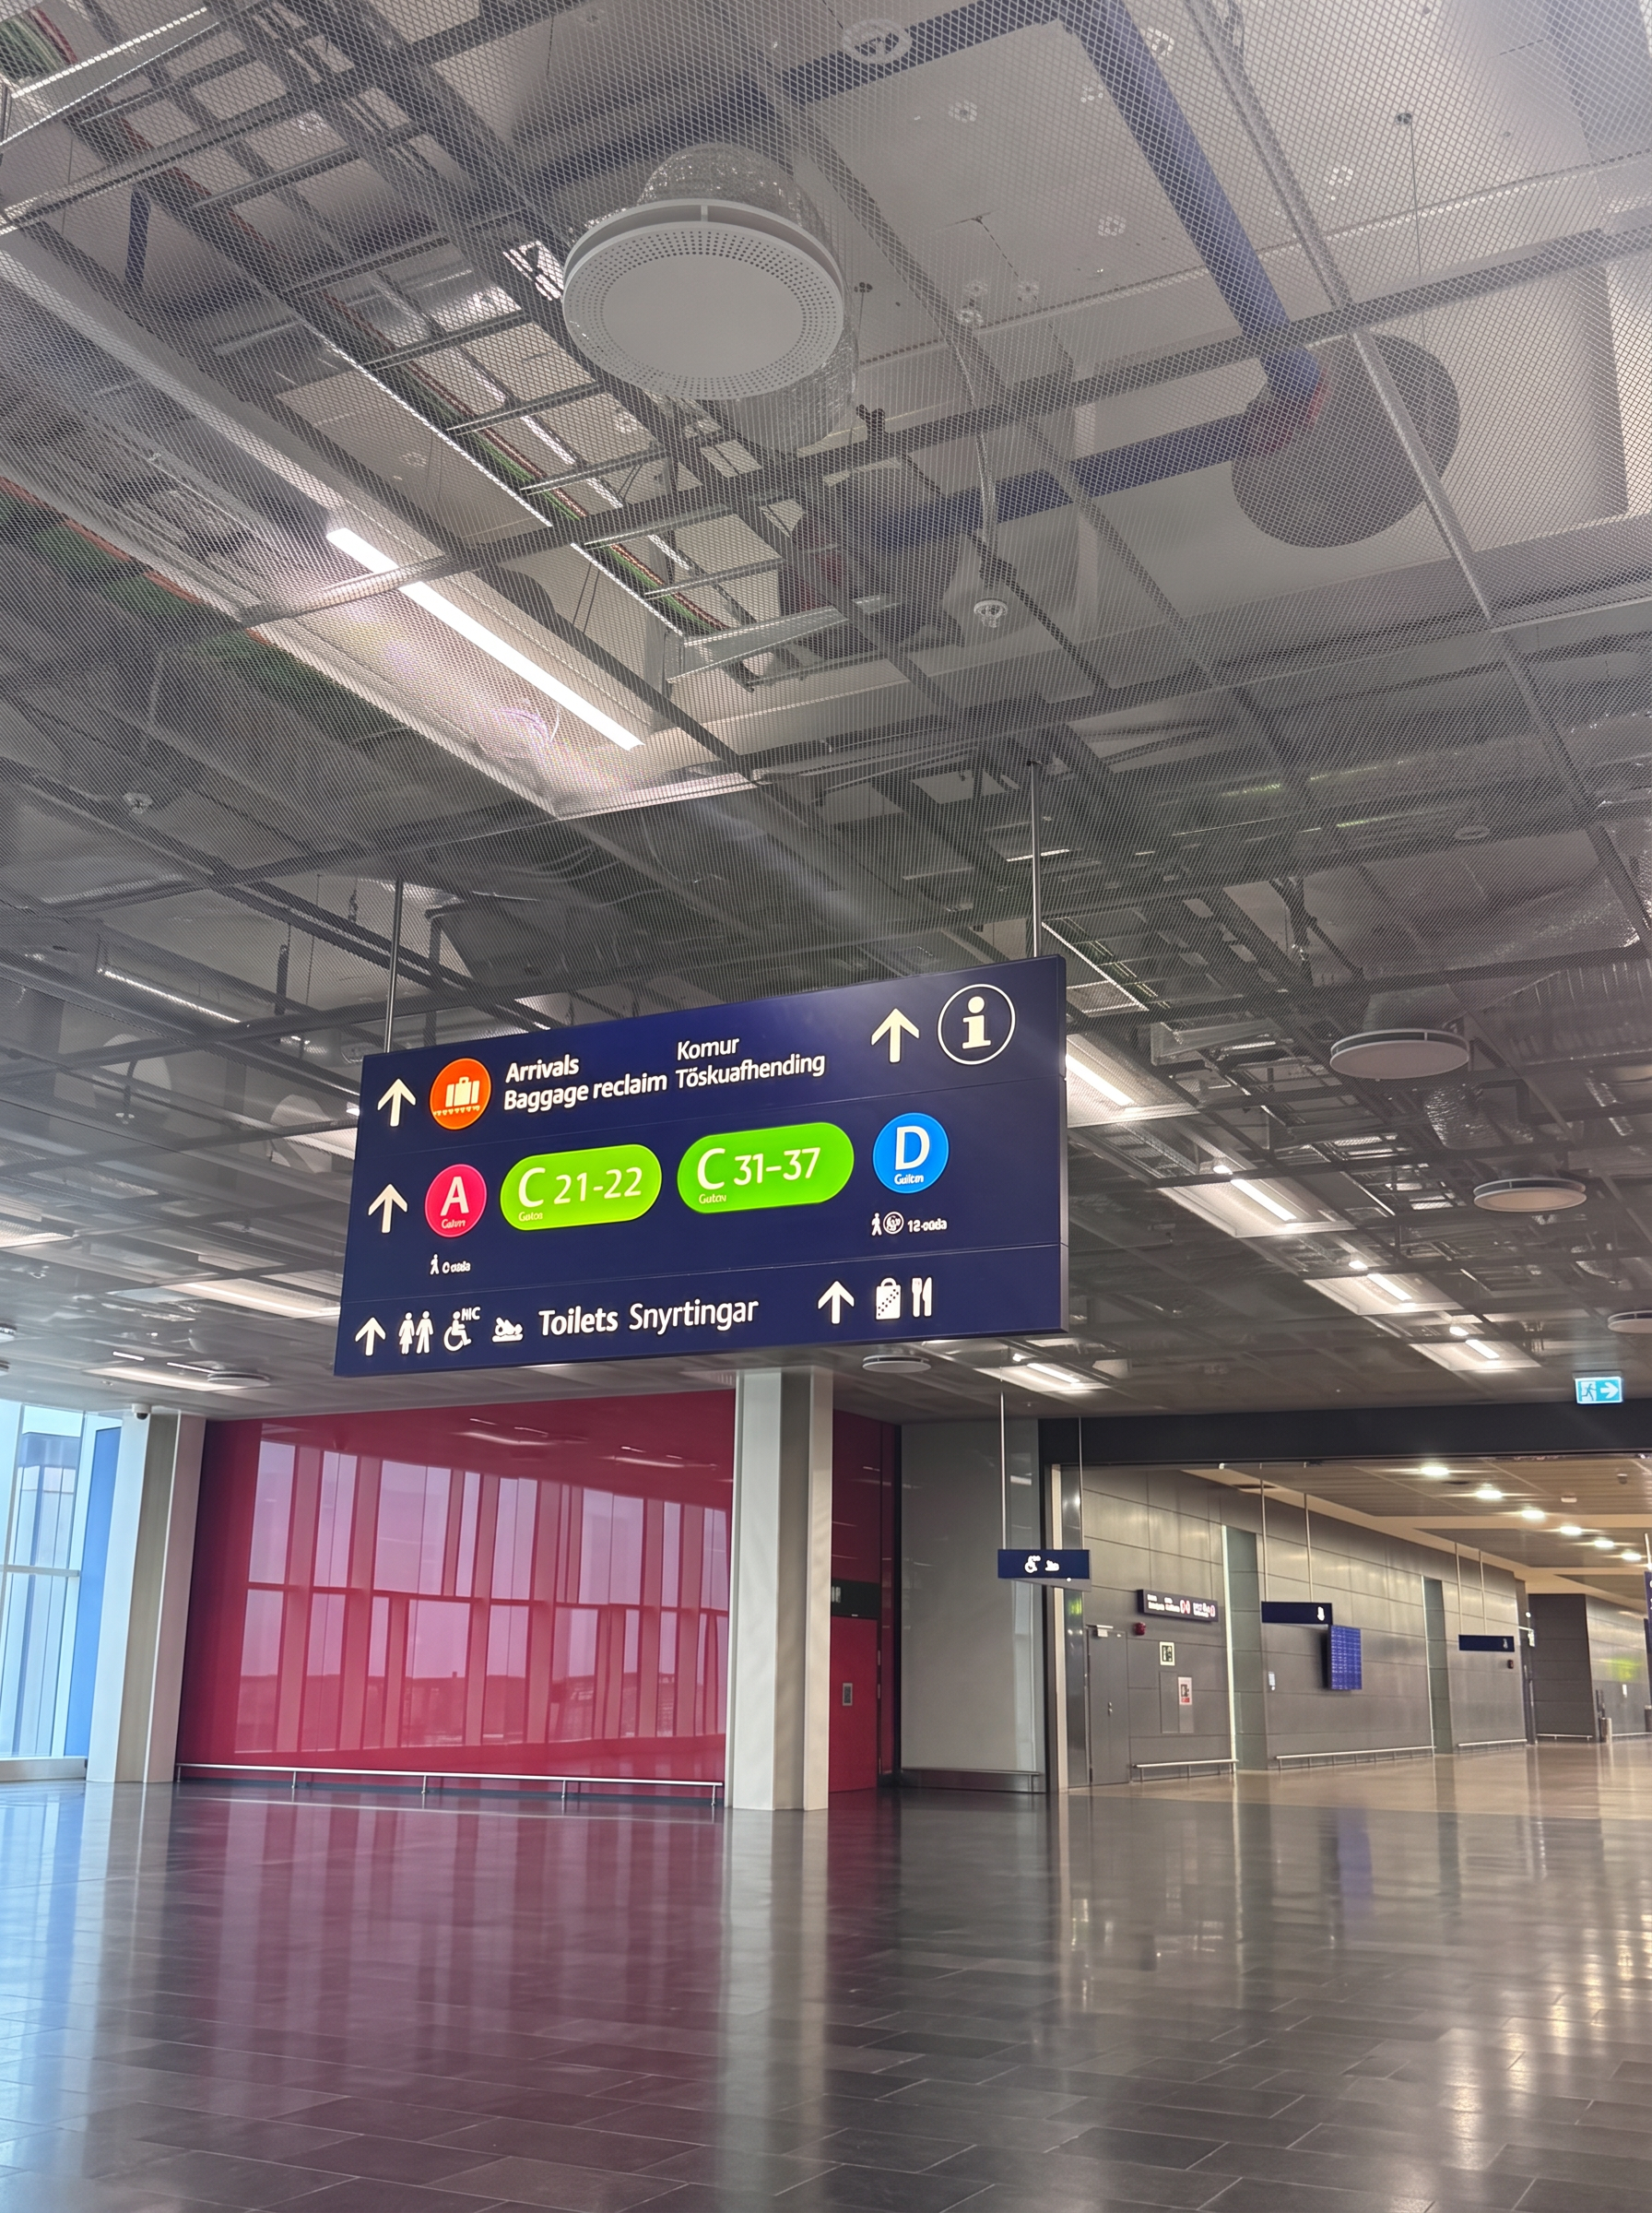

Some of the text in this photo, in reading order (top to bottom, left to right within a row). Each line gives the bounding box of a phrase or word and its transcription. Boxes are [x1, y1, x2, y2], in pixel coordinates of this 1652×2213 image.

[505, 1054, 580, 1083] Arrivals
[677, 1038, 739, 1061] Komur
[676, 1054, 825, 1088] Töskuafhending
[504, 1073, 667, 1113] Baggage reclaim
[895, 1126, 930, 1170] D
[518, 1166, 643, 1208] C 21-22
[697, 1147, 820, 1190] C 31-37
[440, 1176, 469, 1216] A
[538, 1299, 759, 1336] Toilets Snyrtingar
